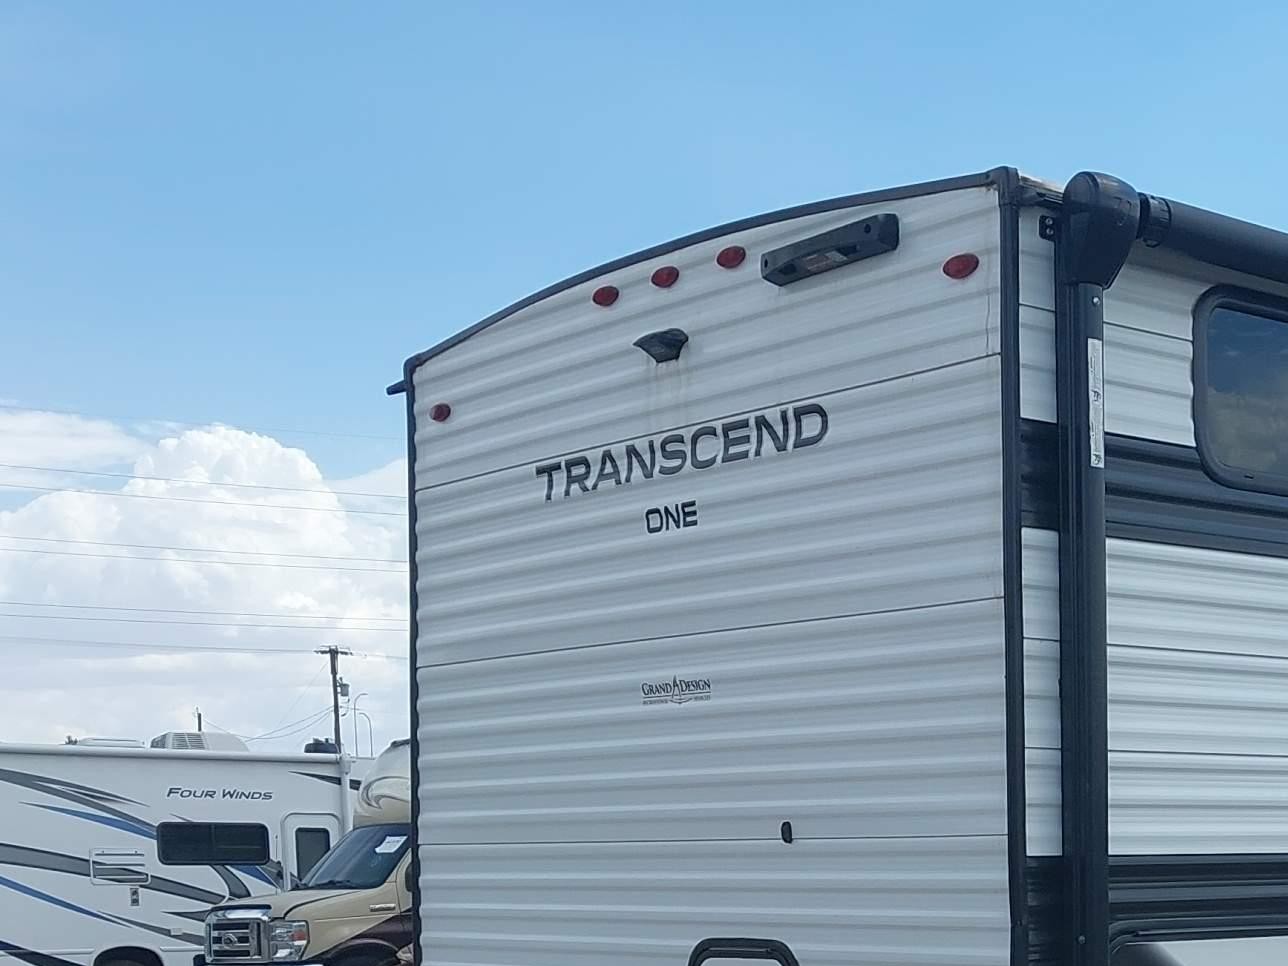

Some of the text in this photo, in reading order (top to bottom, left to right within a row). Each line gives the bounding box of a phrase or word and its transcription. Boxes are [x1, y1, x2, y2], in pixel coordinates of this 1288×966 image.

[535, 402, 829, 501] TRANSCEND
[645, 500, 698, 534] ONE
[641, 679, 711, 696] GRAND DESIGN
